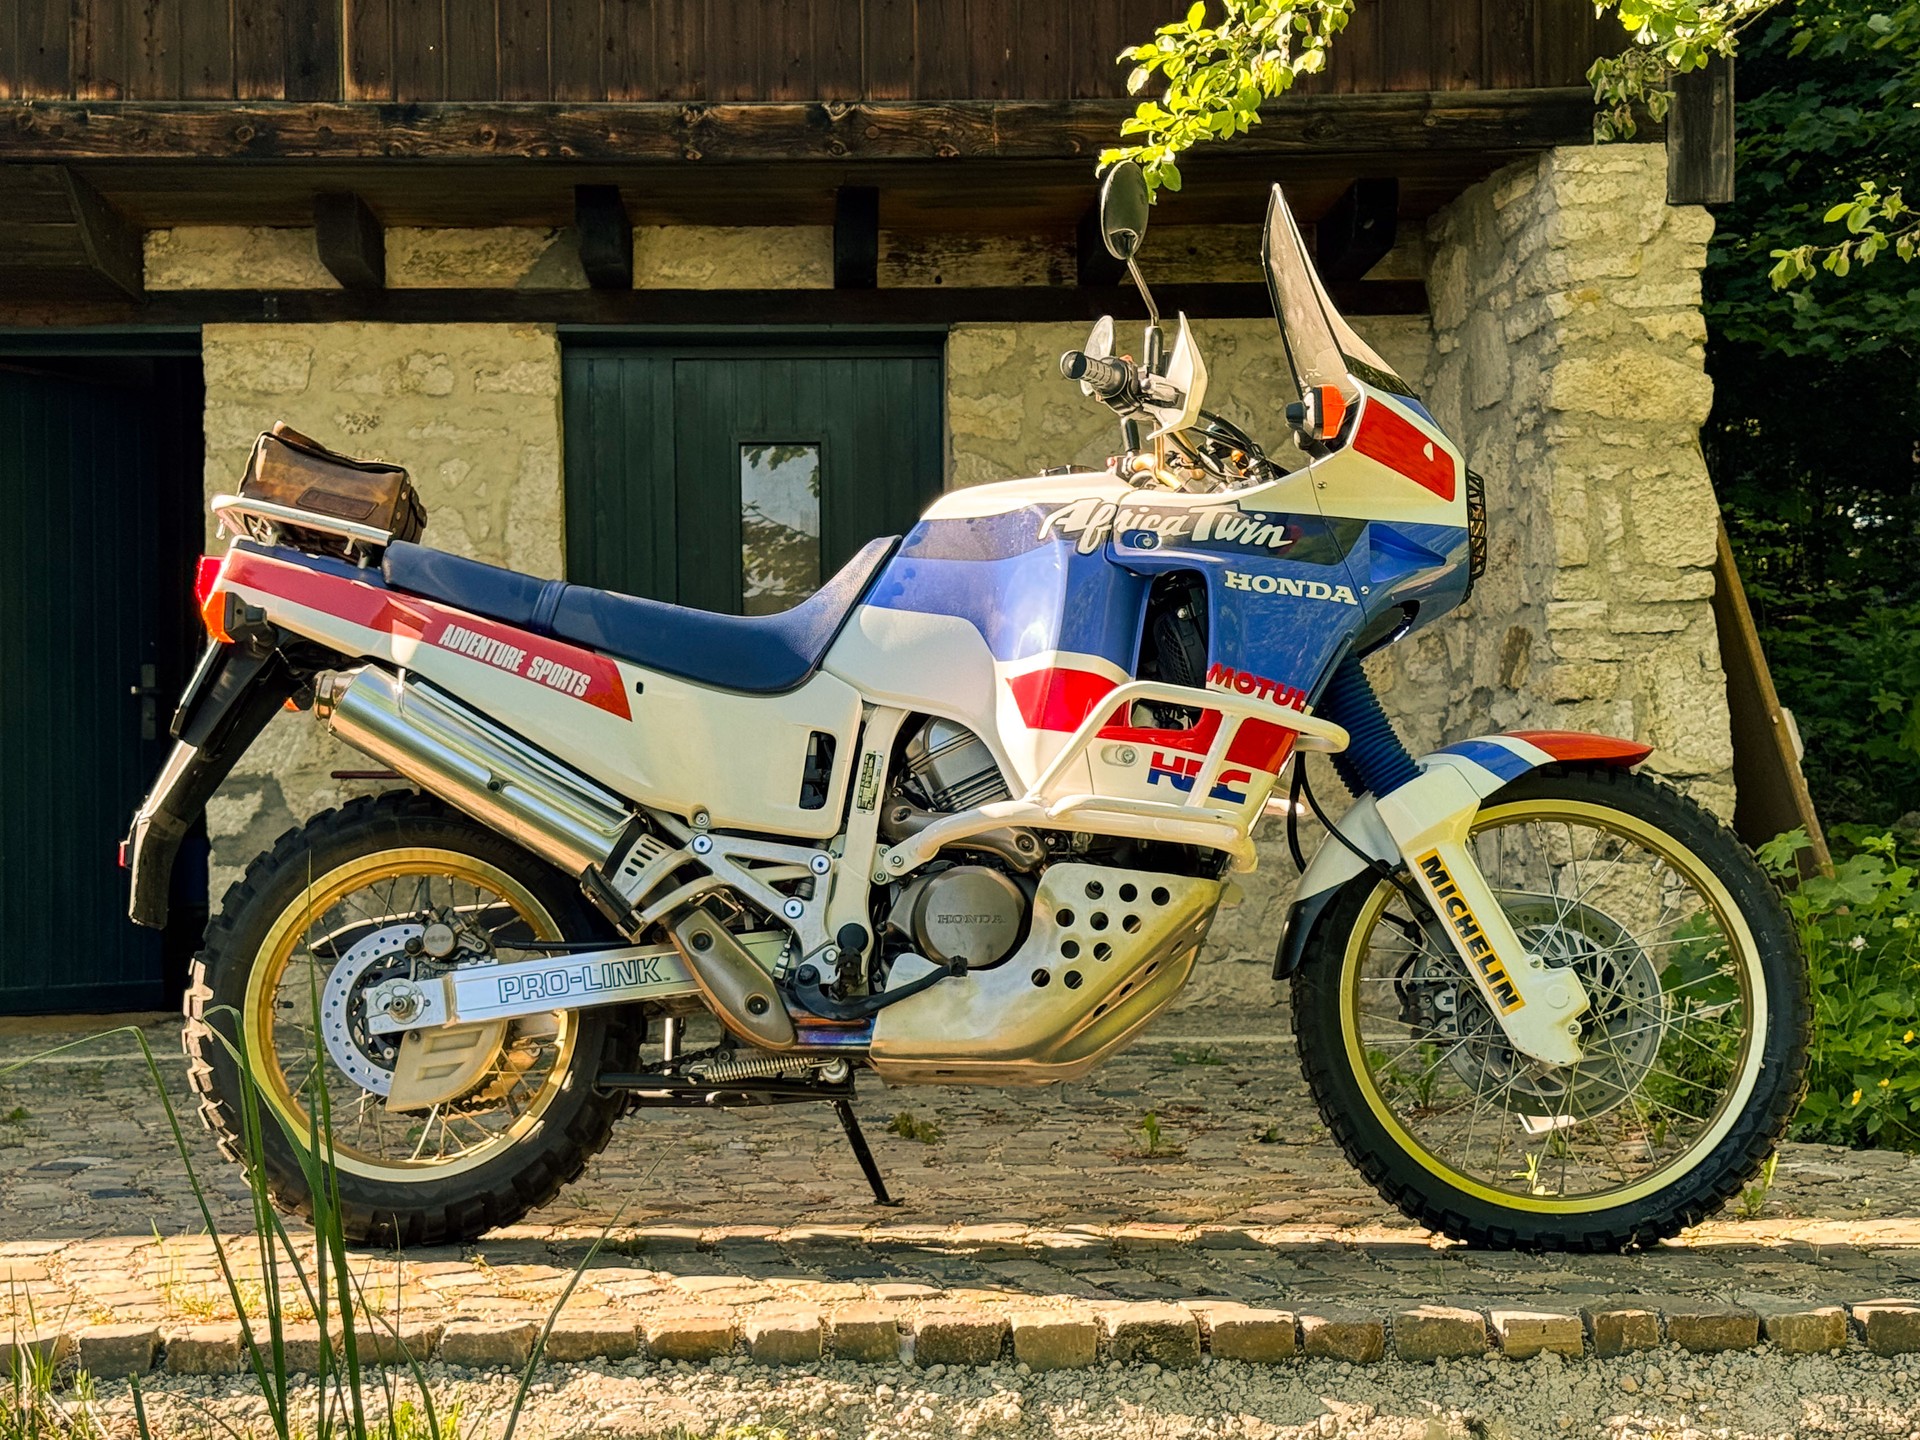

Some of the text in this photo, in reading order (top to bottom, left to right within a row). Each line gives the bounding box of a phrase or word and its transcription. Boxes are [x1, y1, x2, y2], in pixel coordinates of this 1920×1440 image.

[1037, 497, 1293, 554] Africa Twin
[1224, 570, 1359, 605] HONDA
[437, 623, 592, 698] ADVENTURE SPORTS
[1206, 662, 1307, 714] MOTUL
[937, 913, 1006, 924] HONDA
[1420, 855, 1520, 1009] MICHELIN
[498, 957, 663, 1003] PRO-LINK
